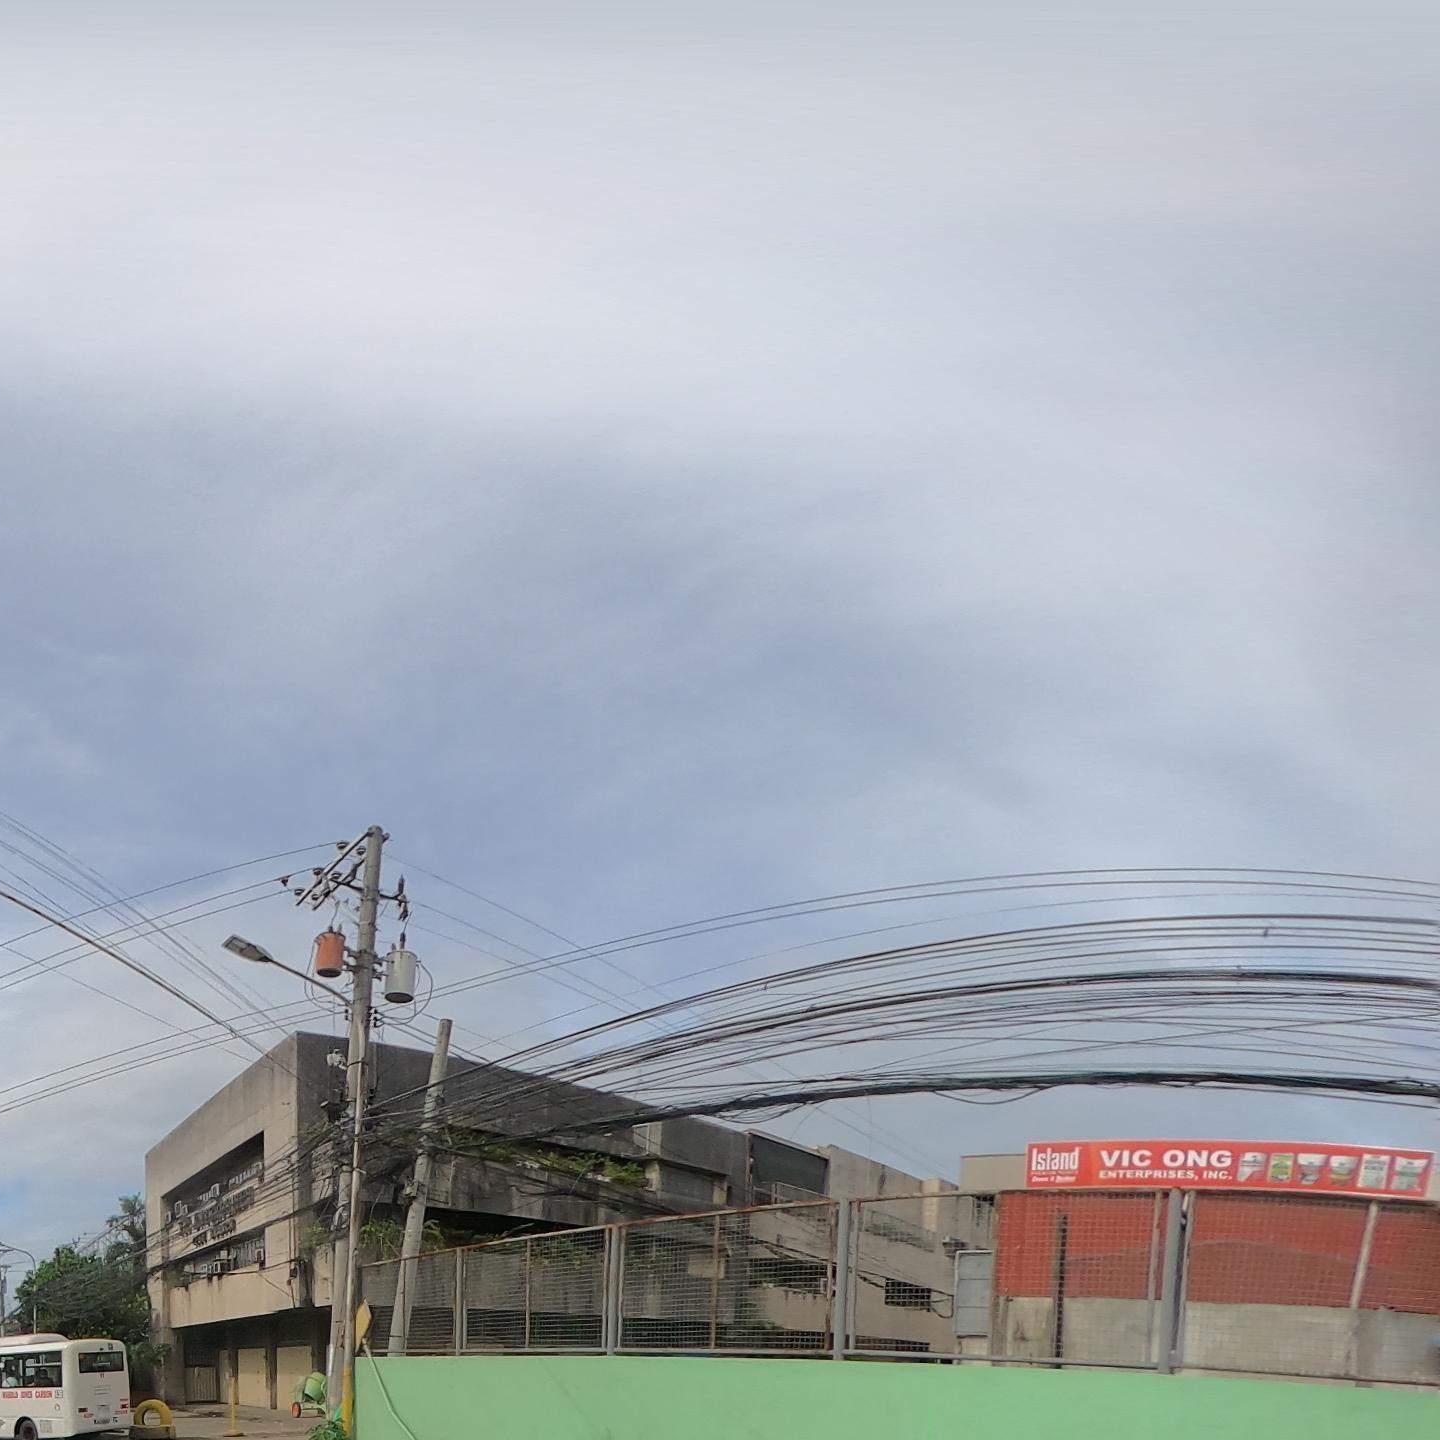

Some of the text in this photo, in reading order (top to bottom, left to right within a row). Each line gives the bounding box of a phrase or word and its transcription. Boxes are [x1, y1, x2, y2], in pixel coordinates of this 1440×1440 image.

[1031, 1146, 1080, 1171] Island
[1100, 1149, 1233, 1168] VIC ONG
[1099, 1169, 1233, 1181] ENTERPRISES, INC.
